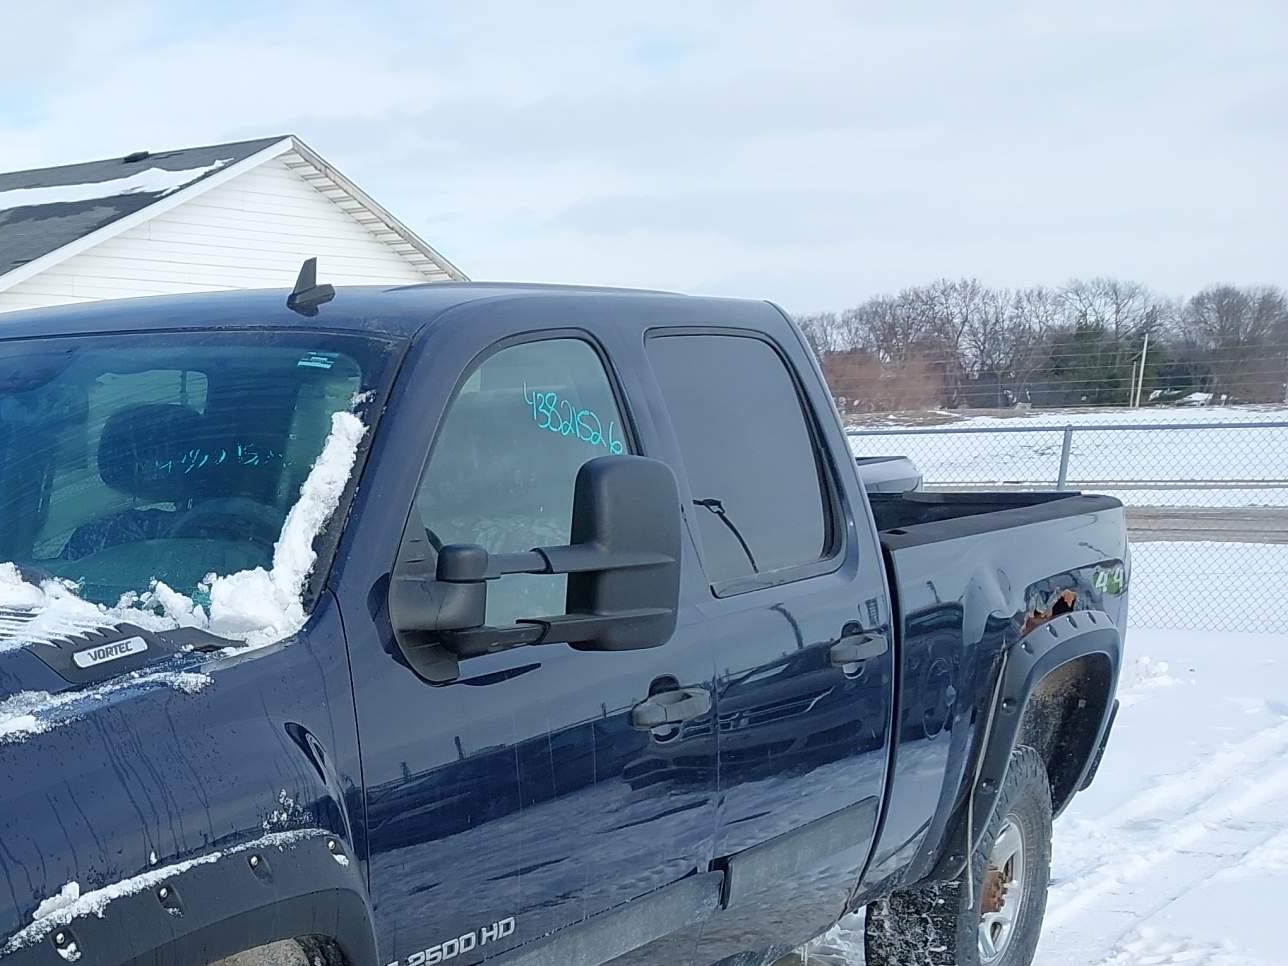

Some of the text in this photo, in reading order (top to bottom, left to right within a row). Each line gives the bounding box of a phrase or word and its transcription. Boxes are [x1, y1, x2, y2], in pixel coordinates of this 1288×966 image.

[523, 380, 623, 455] 43821526
[1095, 567, 1124, 593] 44
[88, 640, 133, 661] VORTEC
[479, 916, 515, 946] HD
